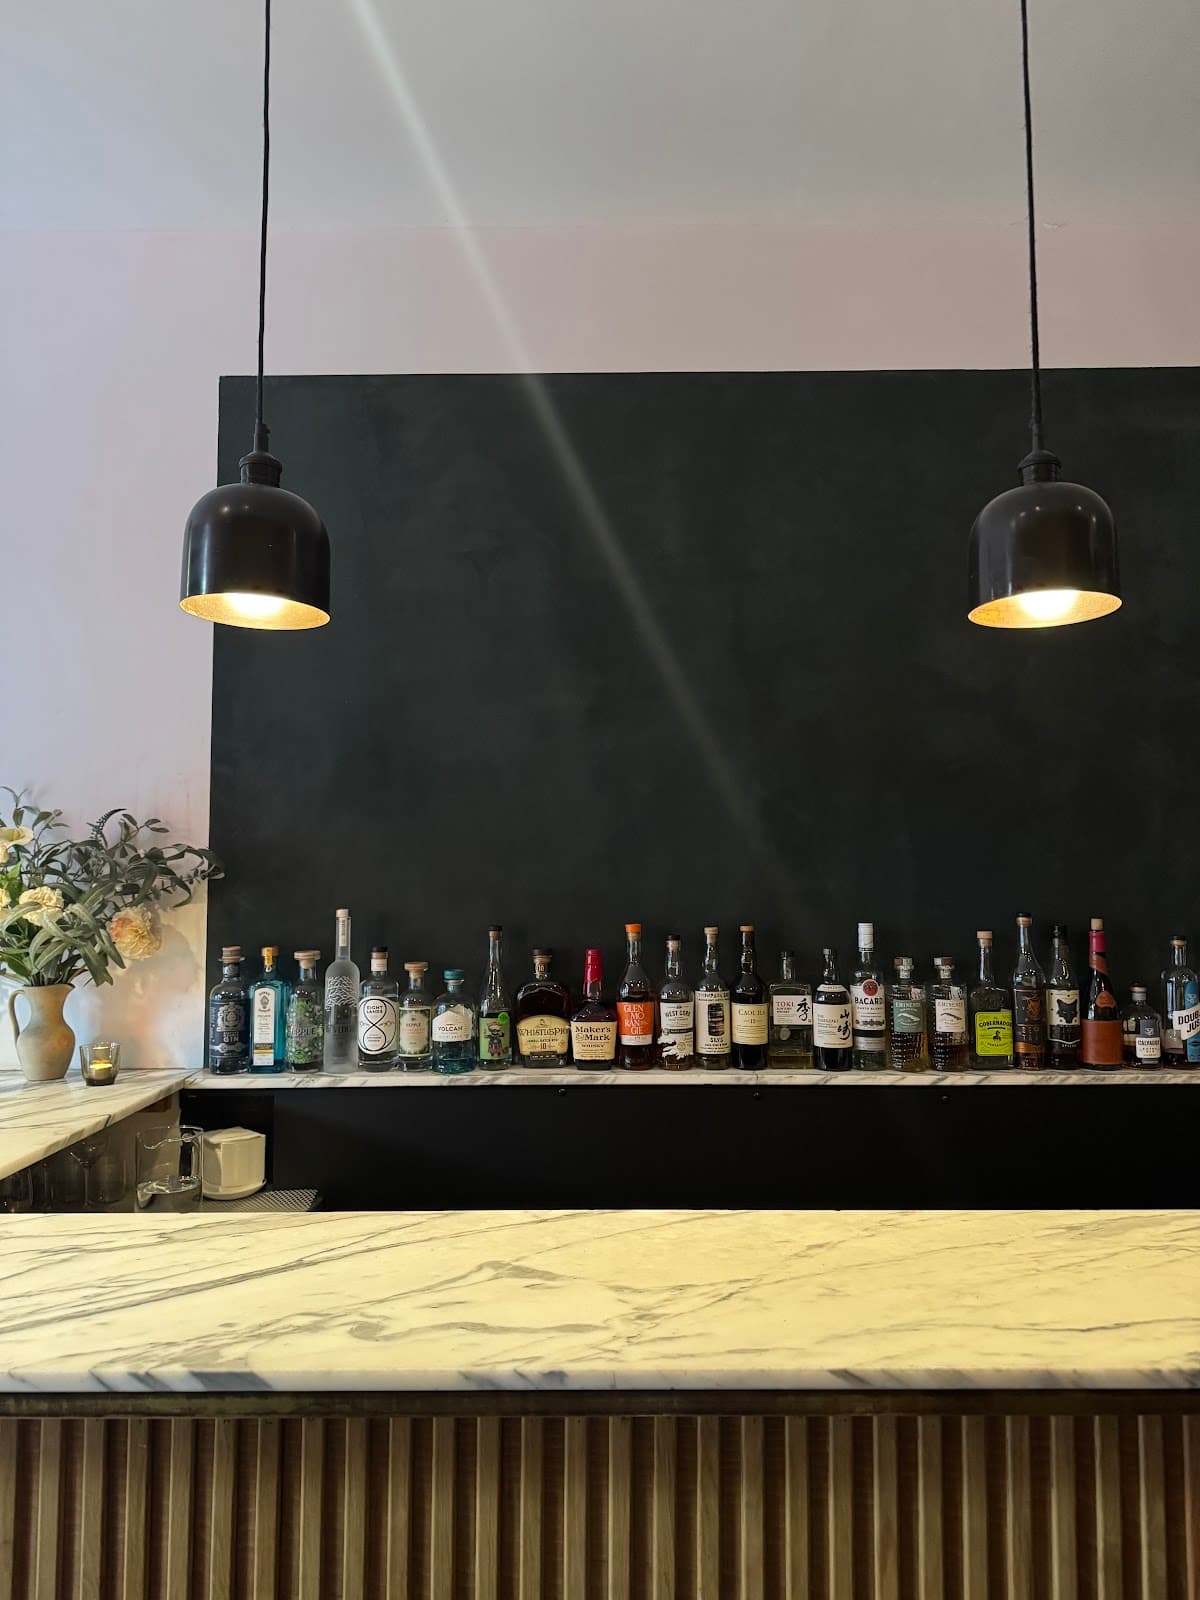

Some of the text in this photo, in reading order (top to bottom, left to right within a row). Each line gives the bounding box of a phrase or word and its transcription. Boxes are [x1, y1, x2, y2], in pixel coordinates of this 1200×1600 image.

[623, 1004, 643, 1012] GLEN
[738, 1008, 754, 1016] CAOL
[630, 1012, 645, 1020] MO
[1178, 1010, 1200, 1025] DOUB
[630, 1027, 643, 1035] GIE
[584, 1033, 609, 1041] Mark
